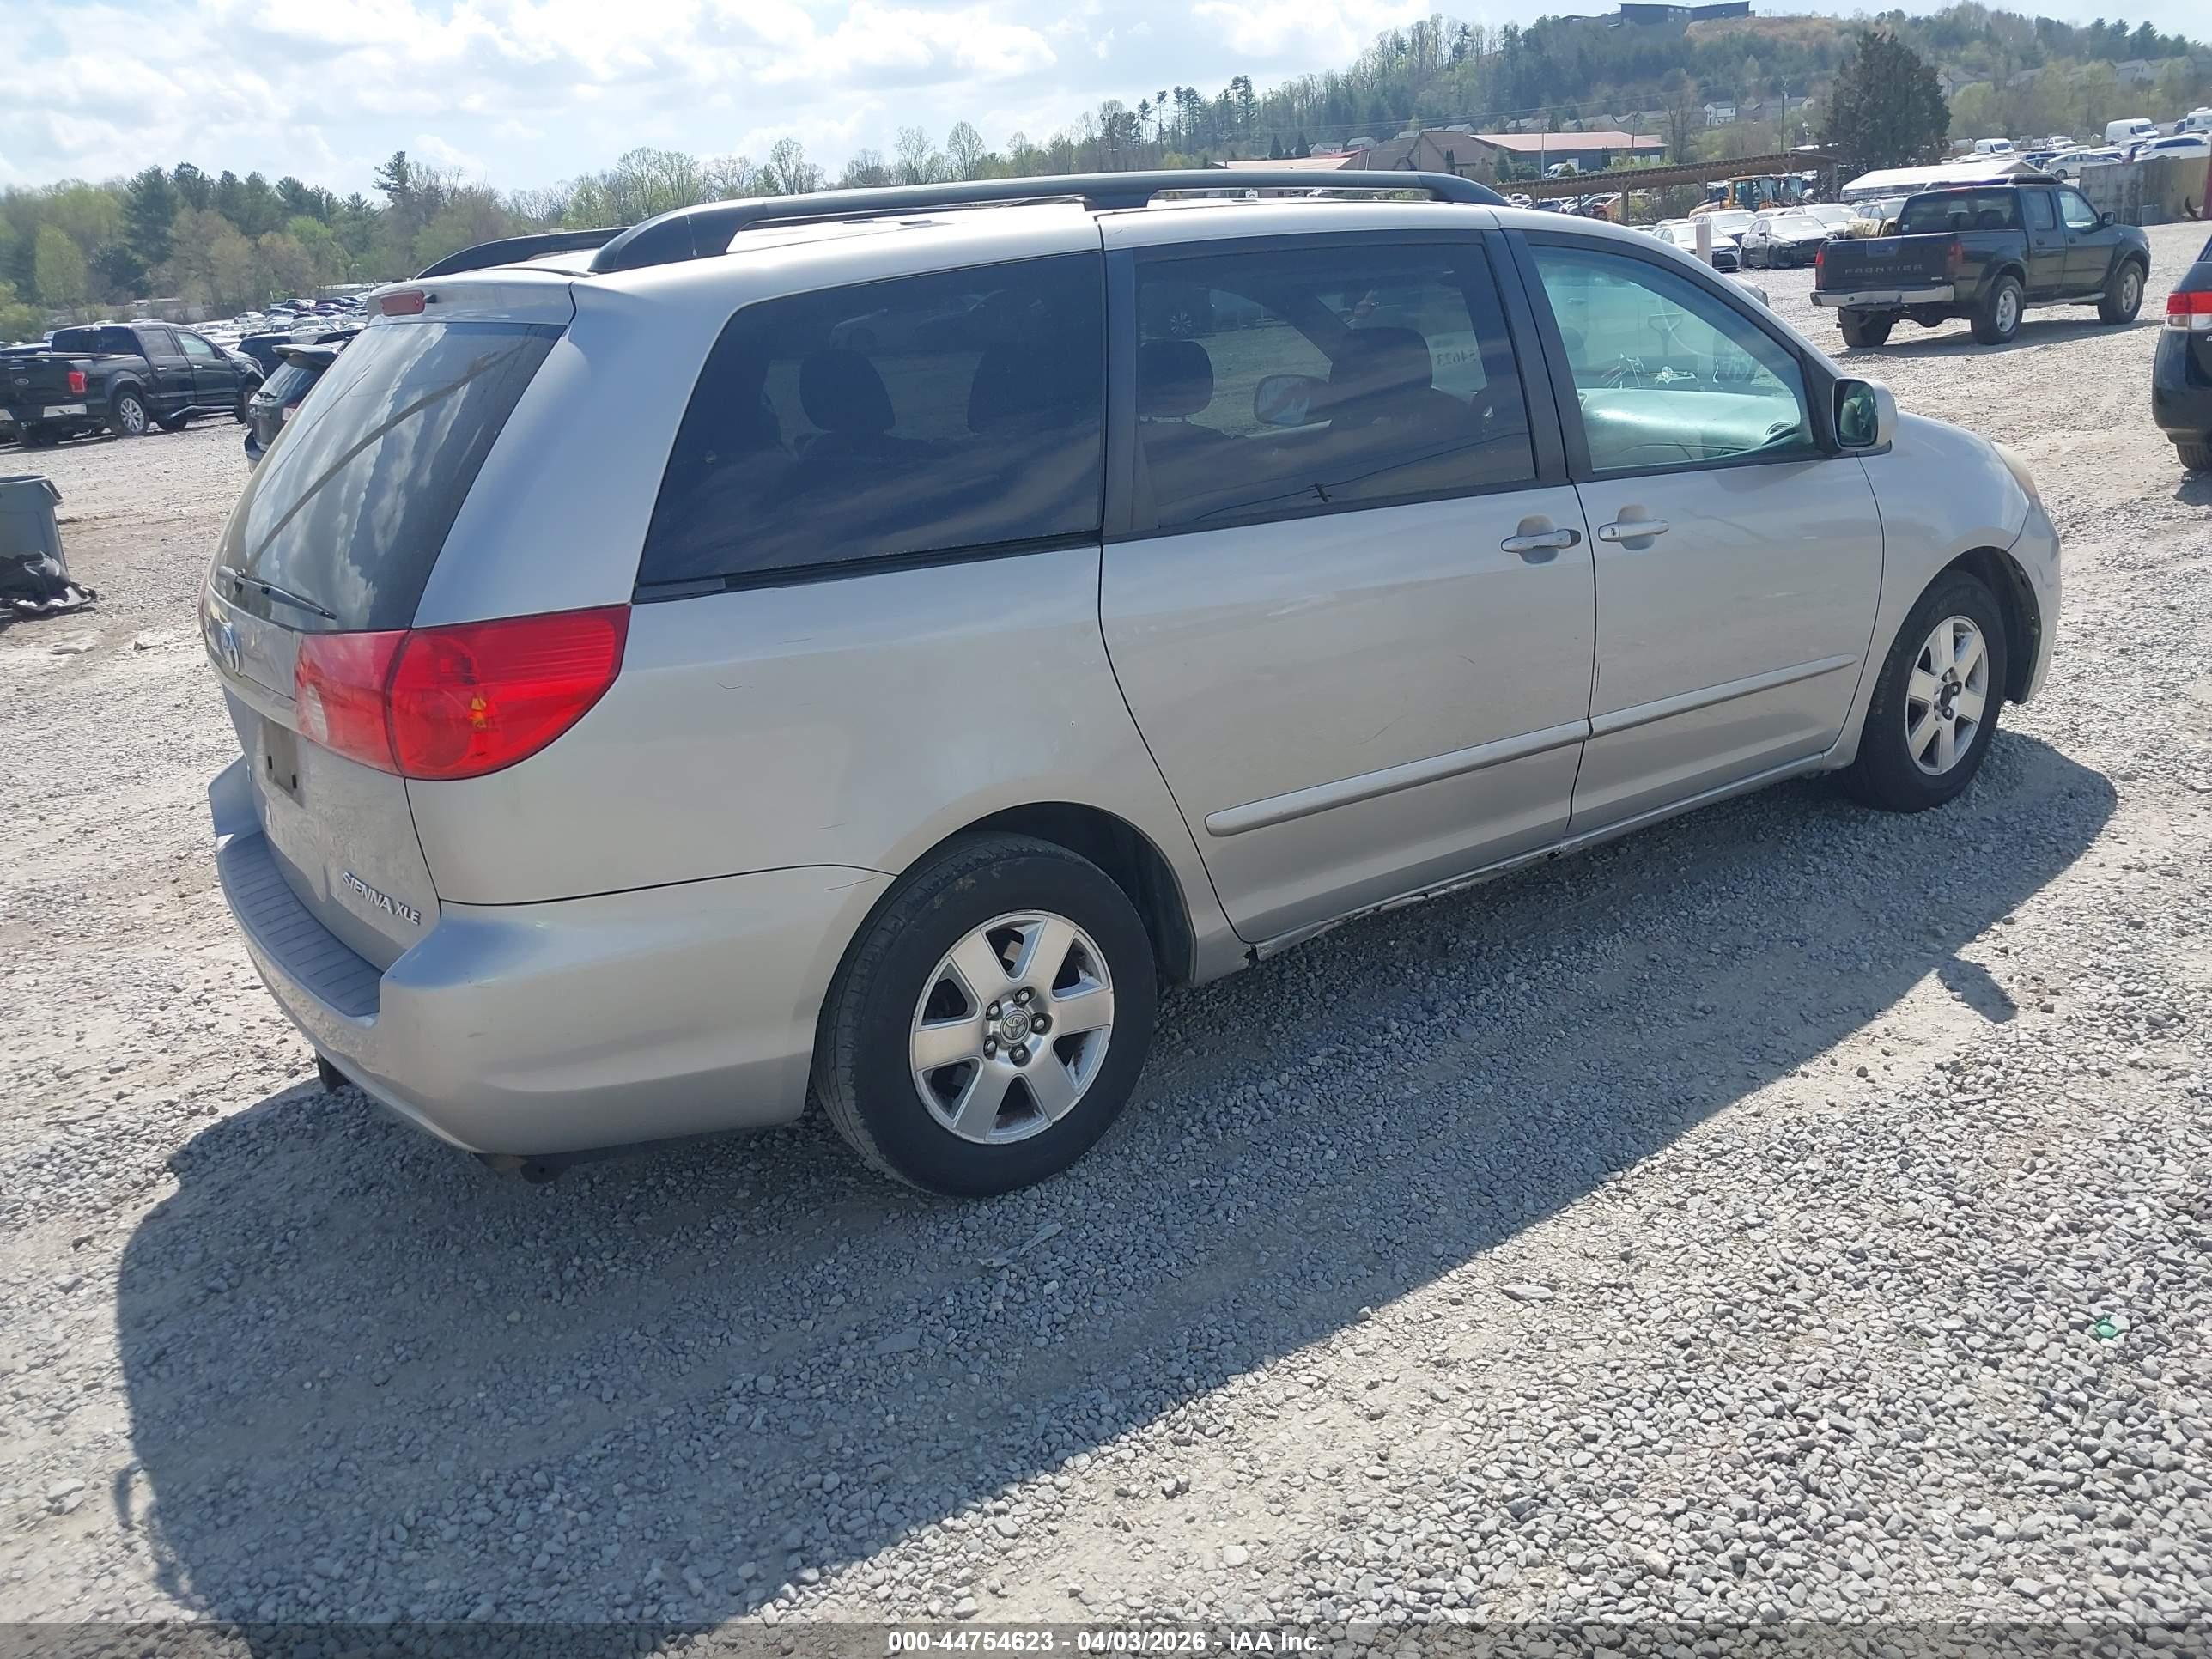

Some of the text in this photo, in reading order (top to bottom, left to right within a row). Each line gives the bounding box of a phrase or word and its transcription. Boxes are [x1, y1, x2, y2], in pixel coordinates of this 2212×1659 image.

[1844, 264, 1923, 275] FRONTIER
[343, 872, 421, 927] SIENNA XLE
